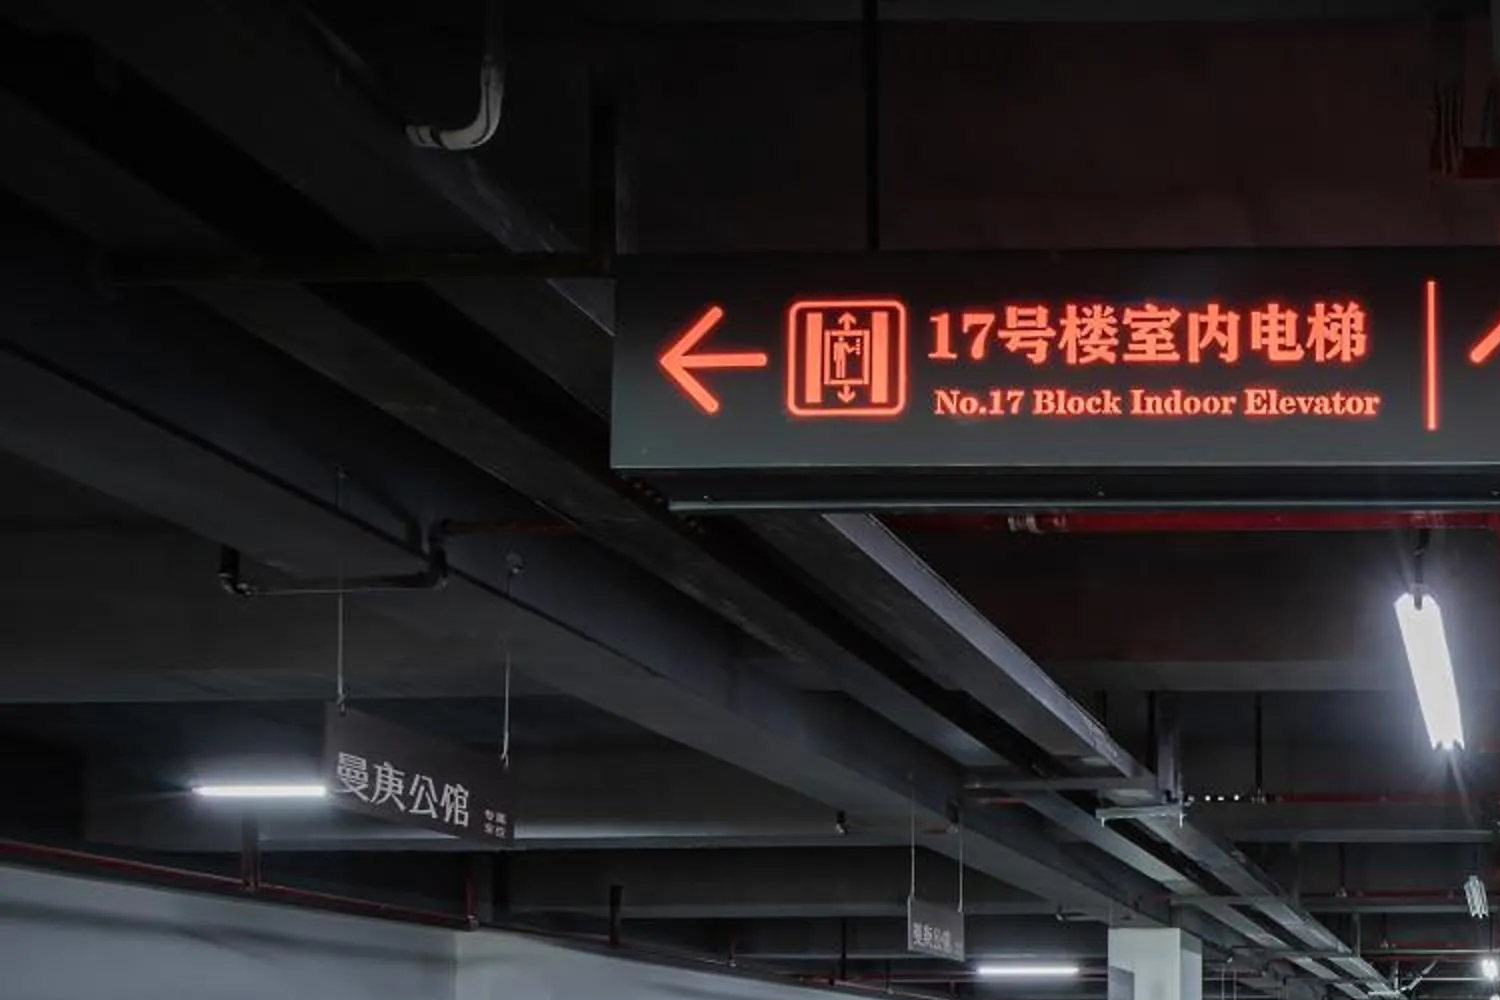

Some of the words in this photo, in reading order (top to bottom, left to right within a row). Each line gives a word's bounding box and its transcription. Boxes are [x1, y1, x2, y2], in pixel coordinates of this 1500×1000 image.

[928, 301, 1367, 365] 17号楼室内电梯
[935, 389, 1025, 416] No.17
[1032, 388, 1122, 416] Block
[1130, 388, 1237, 416] Indoor
[1243, 388, 1381, 416] Elevator
[335, 752, 470, 828] 曼庚公馆
